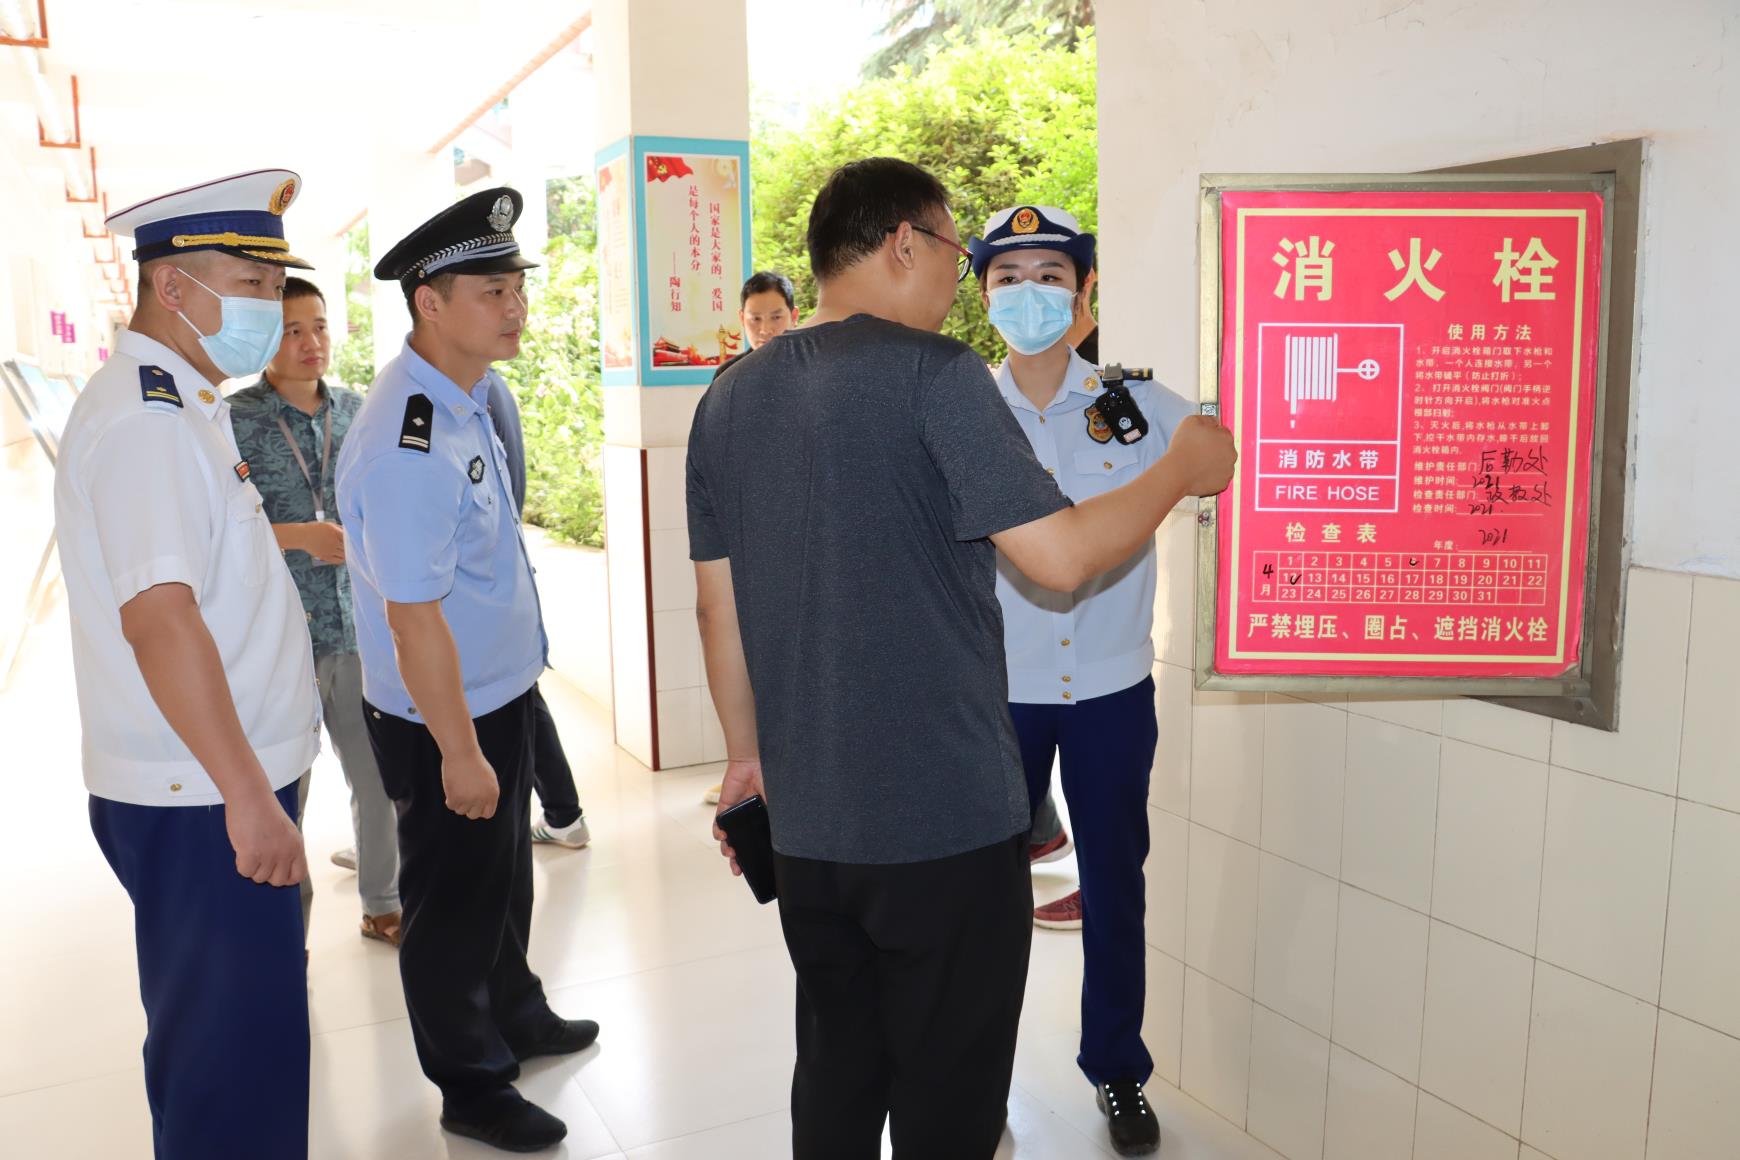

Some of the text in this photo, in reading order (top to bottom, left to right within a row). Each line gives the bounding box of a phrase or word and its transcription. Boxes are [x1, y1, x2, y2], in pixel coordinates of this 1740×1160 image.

[1271, 235, 1559, 303] 消火栓
[1447, 323, 1532, 341] 使用方法
[1278, 449, 1379, 470] 消防水带
[1275, 485, 1380, 501] FIRE HOSE
[1285, 521, 1377, 544] 检查表
[1287, 556, 1293, 566] 1
[1311, 556, 1319, 567] 2
[1336, 556, 1343, 567] 3
[1360, 557, 1368, 567] 4
[1384, 557, 1392, 567] 5
[1434, 558, 1441, 568] 7
[1458, 558, 1466, 568] 8
[1483, 558, 1490, 568] 9
[1503, 559, 1517, 569] 10
[1528, 560, 1541, 569] 11
[1262, 563, 1275, 579] 4
[1308, 573, 1322, 583] 13
[1332, 573, 1346, 584] 14
[1356, 574, 1370, 584] 15
[1381, 574, 1395, 584] 16
[1405, 574, 1419, 584] 17
[1430, 575, 1444, 585] 18
[1454, 575, 1468, 585] 19
[1478, 575, 1493, 585] 20
[1502, 575, 1517, 586] 21
[1527, 576, 1543, 586] 22
[1260, 583, 1271, 596] 月
[1281, 588, 1491, 601] 23 24 25 26 27 28 29 30 31
[1247, 613, 1549, 642] 严禁埋压、圈占、遮挡消火栓
